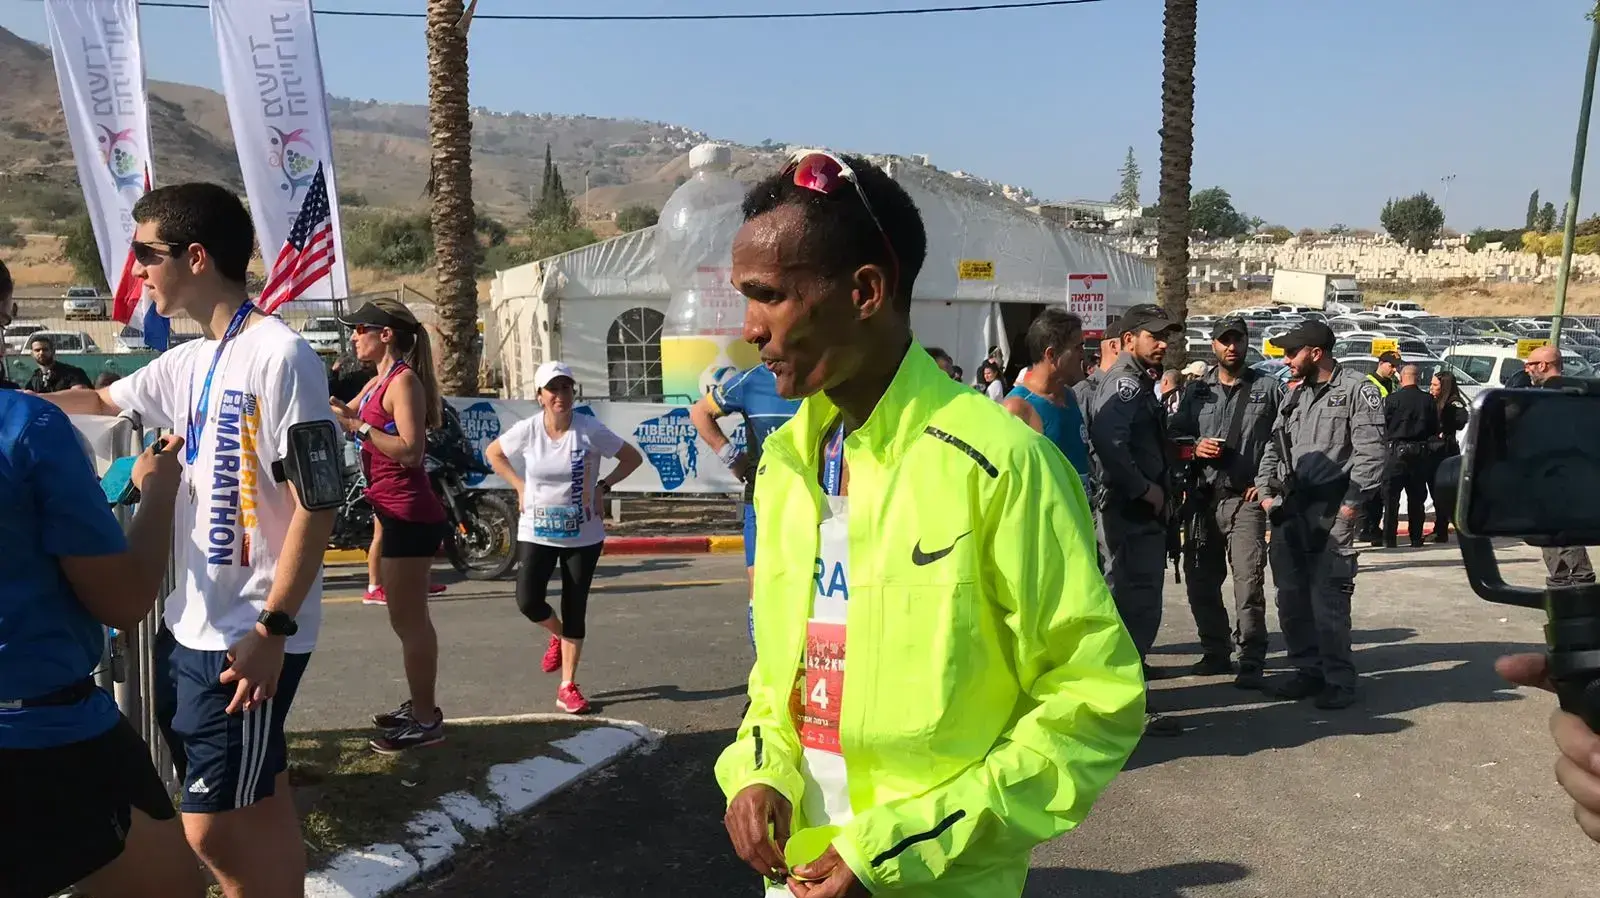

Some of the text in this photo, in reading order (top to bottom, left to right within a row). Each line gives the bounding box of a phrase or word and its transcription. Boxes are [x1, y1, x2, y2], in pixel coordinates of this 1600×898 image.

[1071, 293, 1104, 303] מרפאה
[1071, 303, 1104, 312] CLINIC
[638, 424, 696, 437] TIBERIAS
[208, 414, 241, 566] MARATHON
